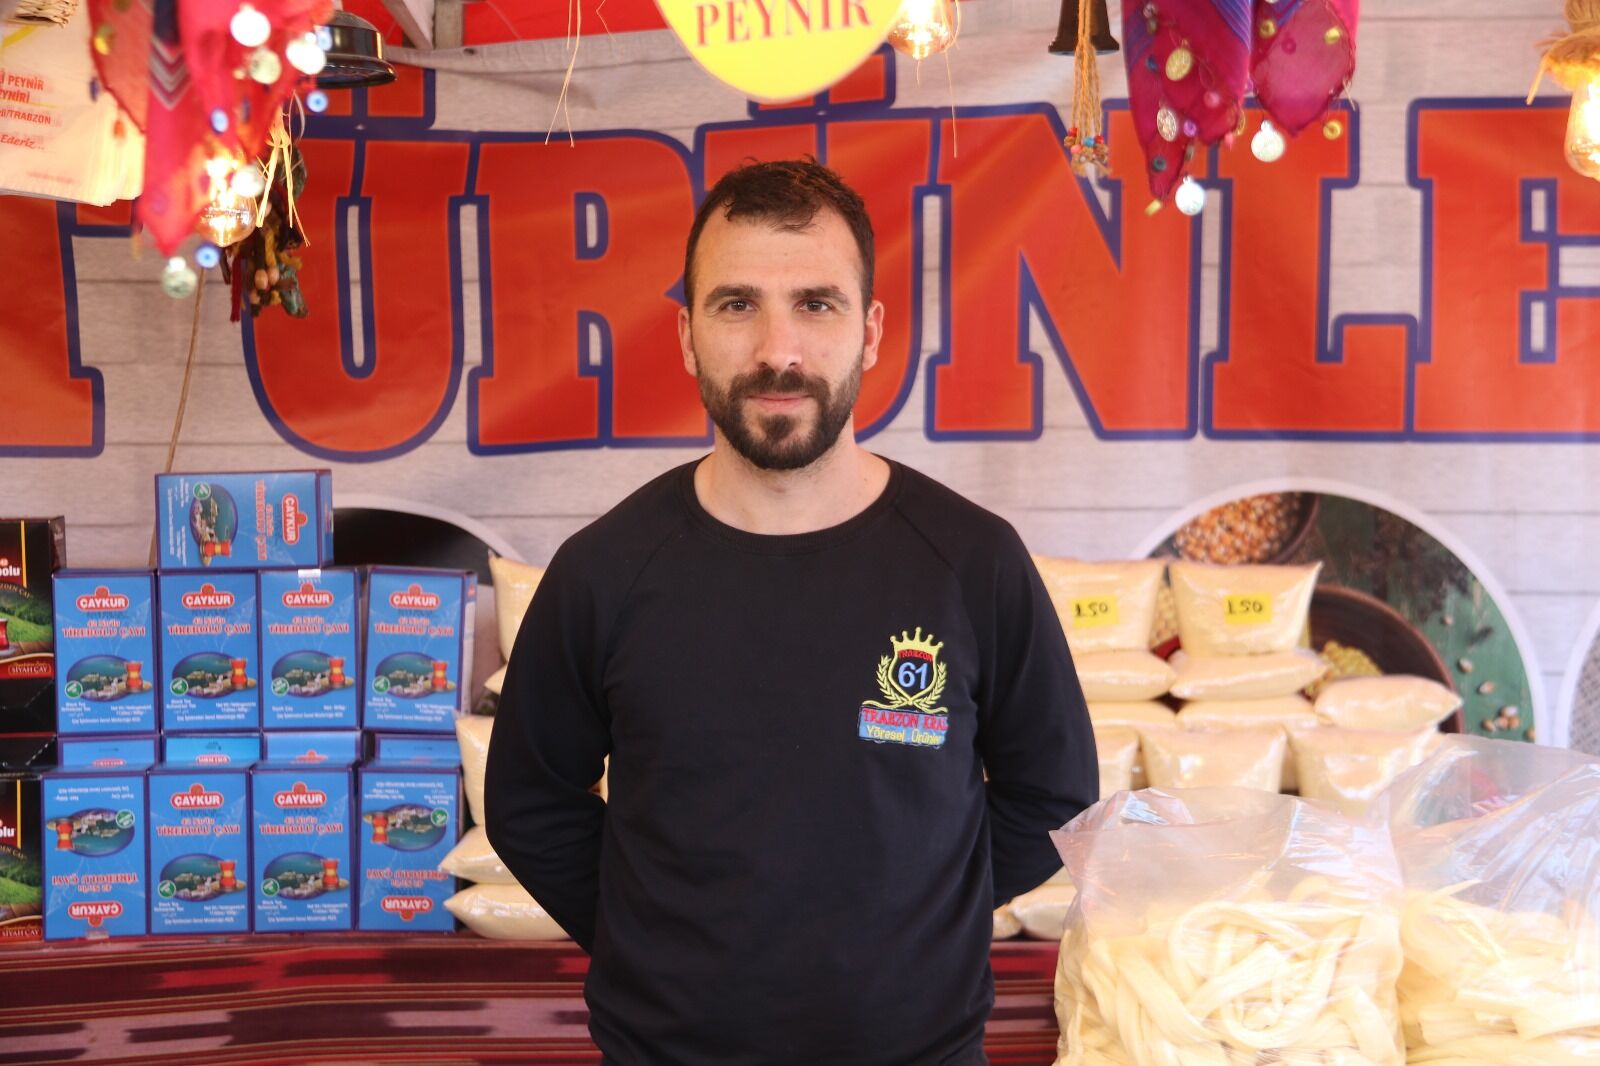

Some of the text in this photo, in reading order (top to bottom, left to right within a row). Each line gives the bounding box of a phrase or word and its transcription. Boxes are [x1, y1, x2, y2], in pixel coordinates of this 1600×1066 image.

[80, 598, 125, 610] ÇAYKUR
[186, 595, 231, 607] ÇAYKUR
[286, 593, 330, 605] ÇAYKUR
[393, 594, 437, 606] ÇAYKUR
[897, 661, 928, 690] 61
[863, 707, 919, 728] TRABZON
[174, 795, 220, 807] ÇAYKUR
[277, 794, 323, 805] ÇAYKUR
[72, 902, 119, 914] ÇAYKUR
[385, 897, 430, 909] ÇAYKUR
